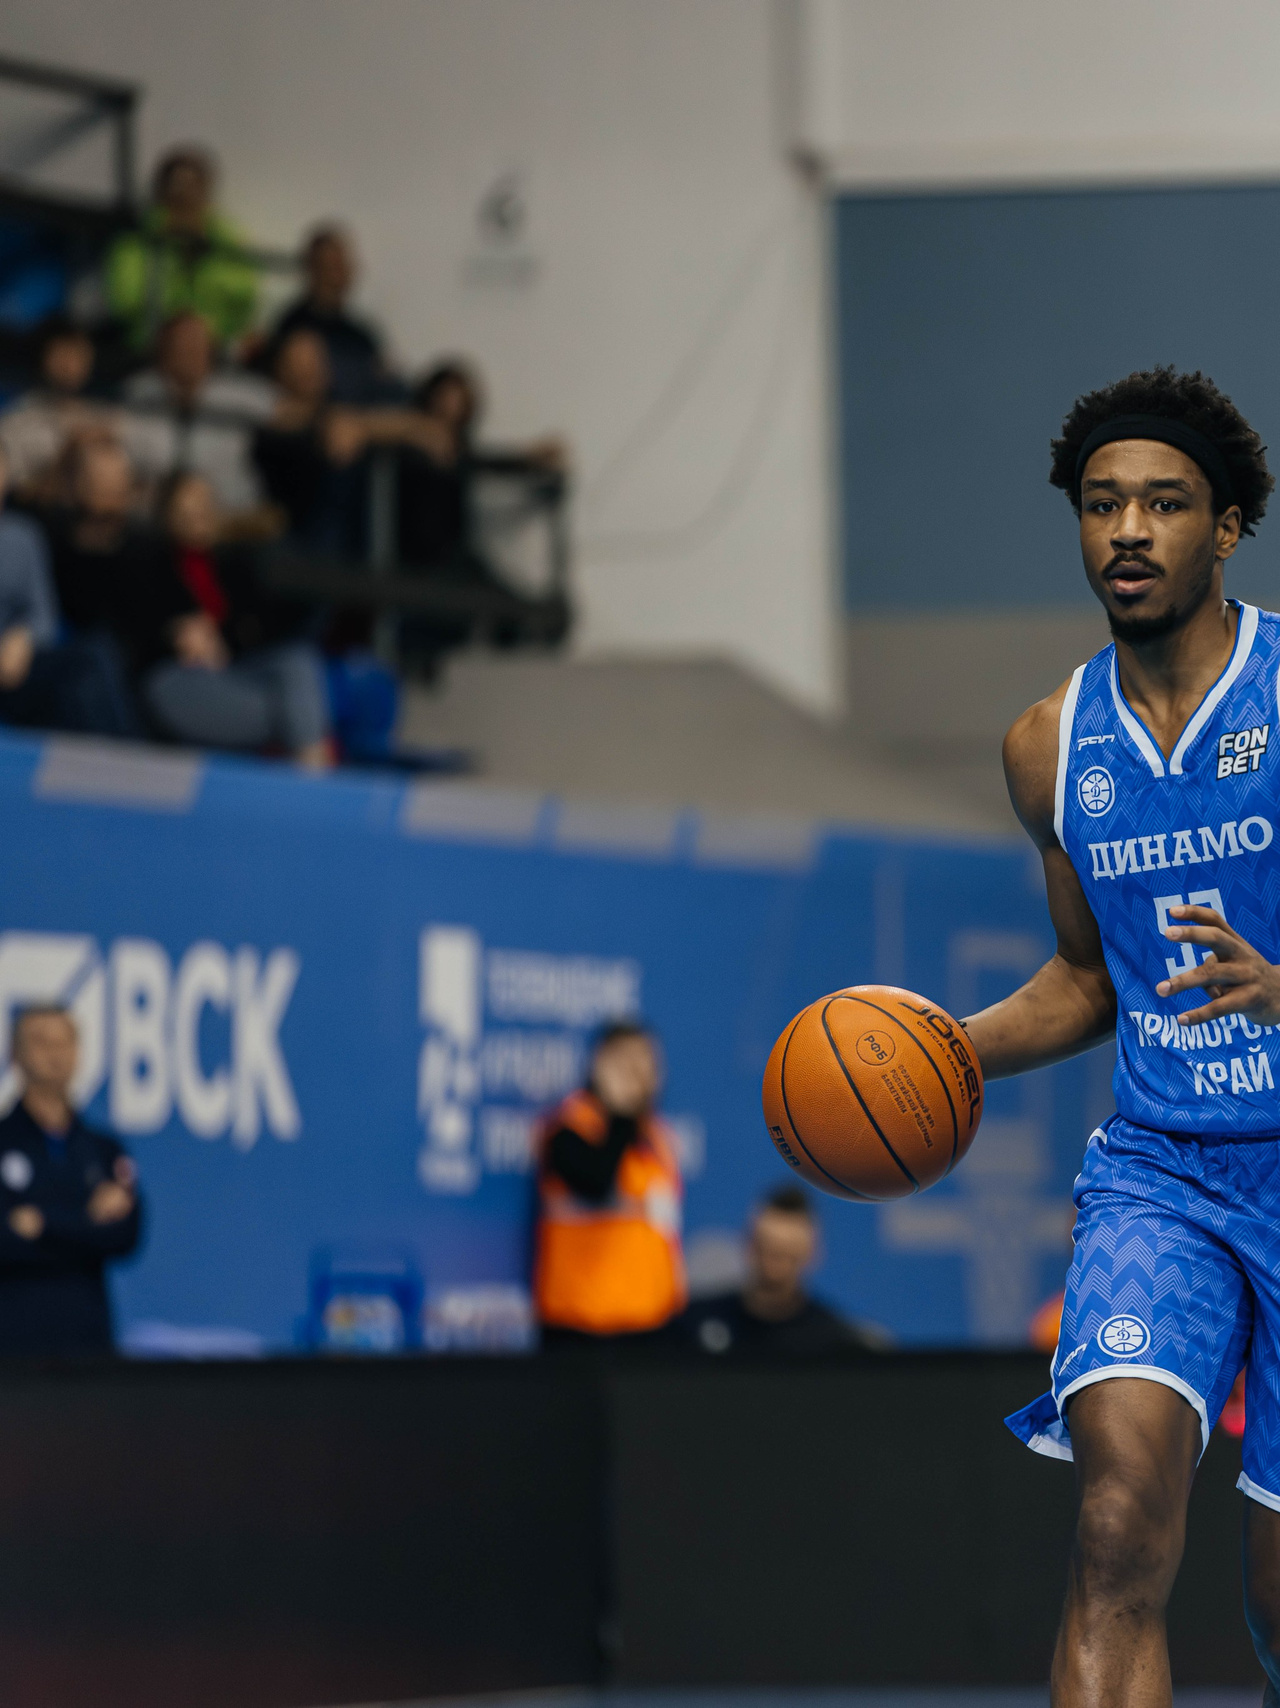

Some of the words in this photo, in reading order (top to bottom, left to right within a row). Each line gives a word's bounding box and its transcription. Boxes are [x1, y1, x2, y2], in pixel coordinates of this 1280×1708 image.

[1218, 722, 1270, 757] FON
[1216, 746, 1266, 780] BET
[1087, 815, 1274, 881] ДИНАМО
[863, 1034, 888, 1061] РФБ
[916, 1020, 947, 1055] OFFICIAL
[946, 1053, 961, 1080] GAME
[958, 1080, 967, 1105] BALL
[890, 1068, 919, 1112] РОССИЙСКОЙ
[1186, 1044, 1275, 1096] КРАЙ
[881, 1073, 908, 1114] БАСКЕТБОЛА
[769, 1125, 801, 1167] FIBA
